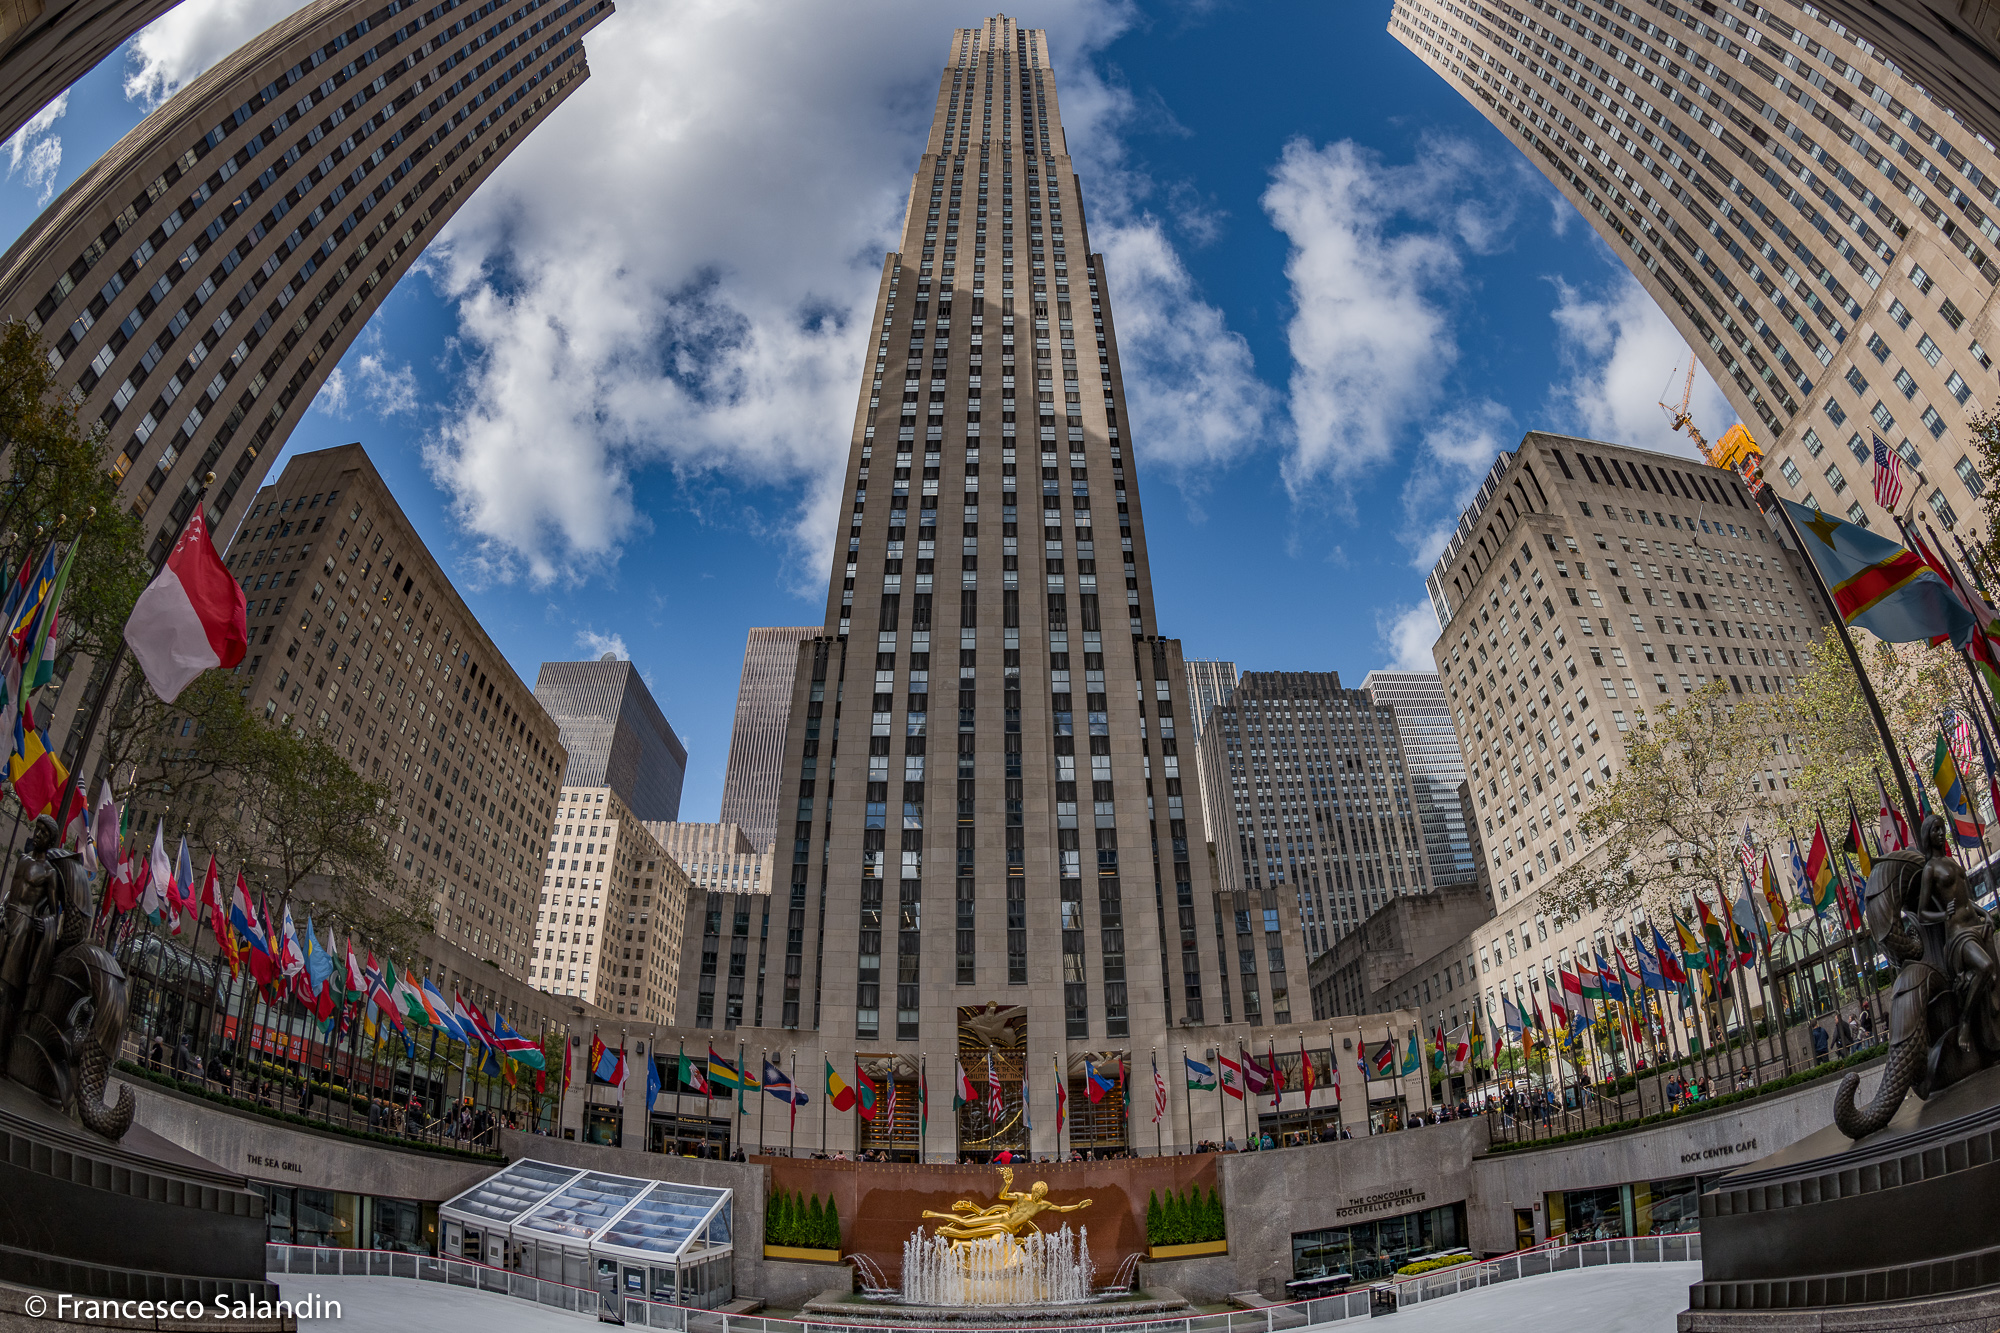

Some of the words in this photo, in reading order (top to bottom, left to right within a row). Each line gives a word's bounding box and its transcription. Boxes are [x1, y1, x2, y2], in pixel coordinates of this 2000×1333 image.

[1681, 1152, 1701, 1163] ROCK
[1703, 1145, 1733, 1159] CENTER
[1736, 1138, 1757, 1152] CAFÉ
[247, 1154, 262, 1165] THE
[265, 1158, 279, 1168] SEA
[282, 1162, 302, 1173] GRILL
[1336, 1202, 1393, 1217] ROCKEFELLER
[1396, 1195, 1426, 1207] CENTER
[1349, 1198, 1364, 1206] THE
[1366, 1188, 1413, 1203] CONCOURSE
